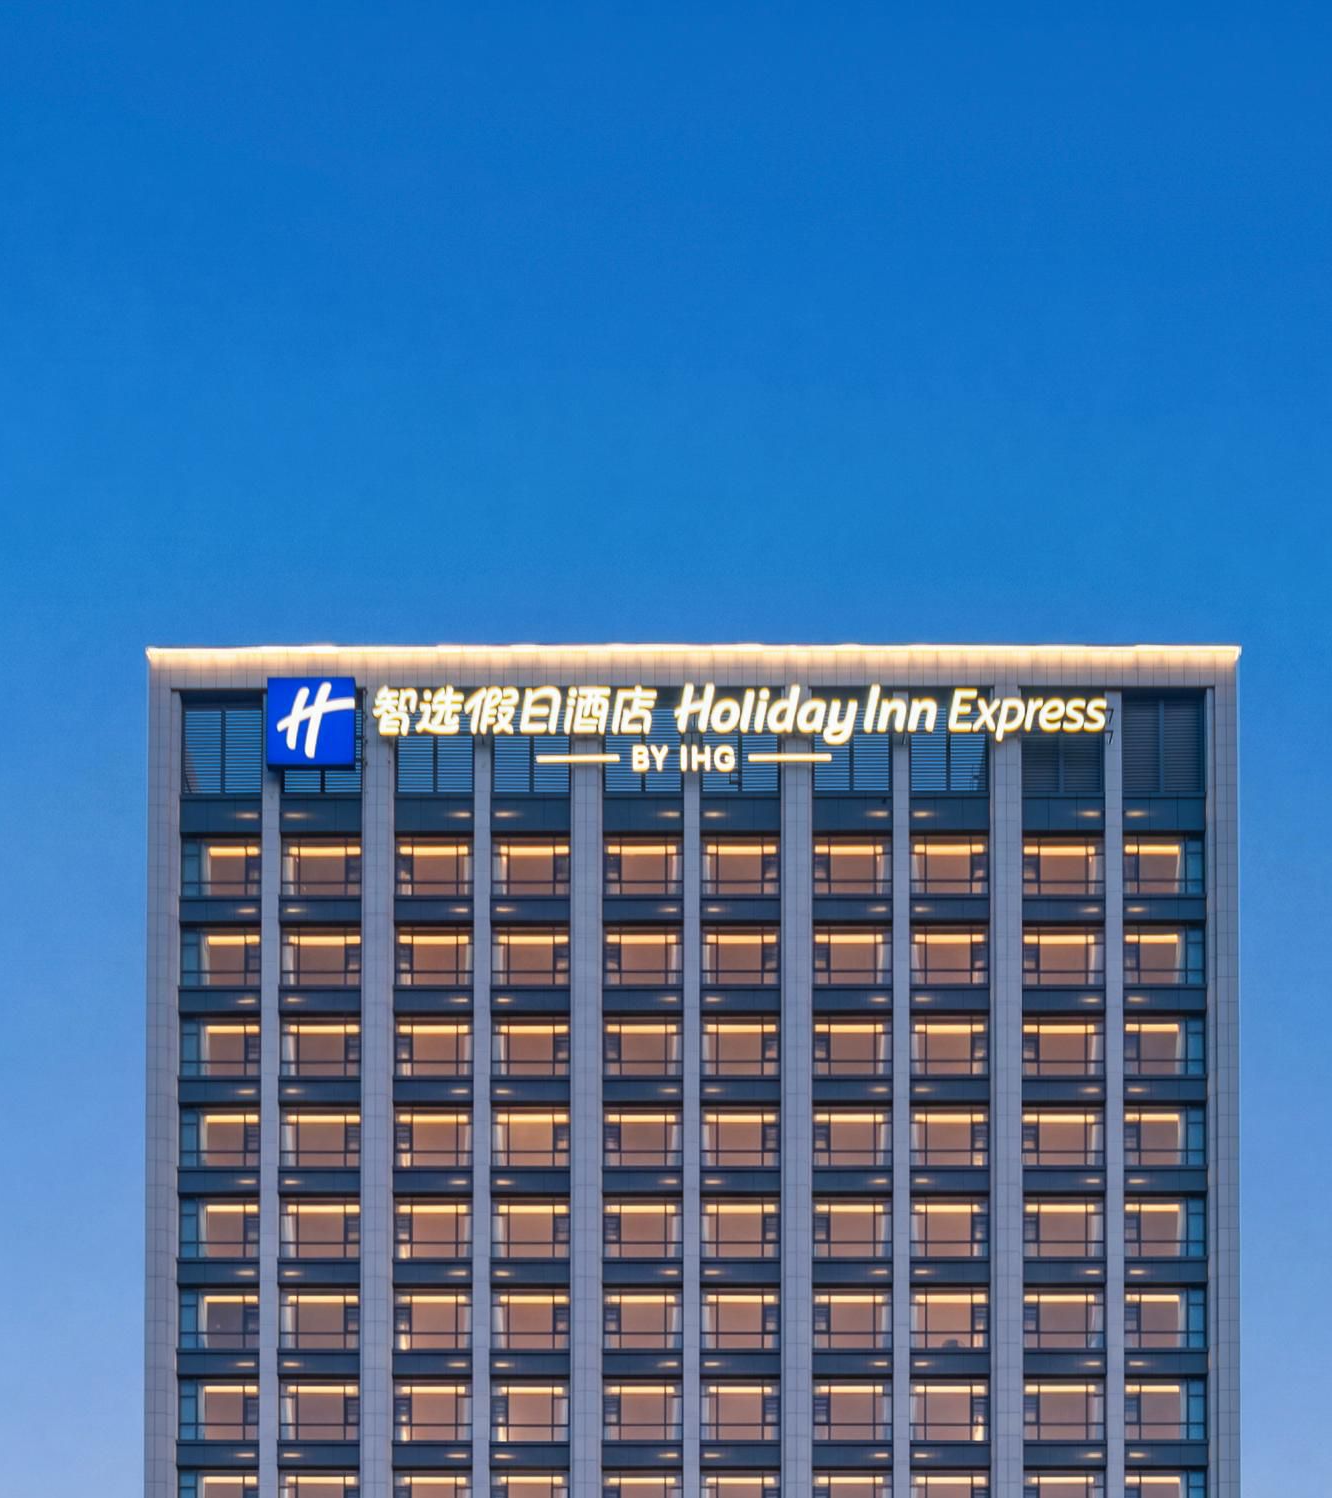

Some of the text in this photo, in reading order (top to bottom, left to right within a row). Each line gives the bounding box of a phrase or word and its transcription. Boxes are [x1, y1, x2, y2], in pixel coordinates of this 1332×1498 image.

[371, 684, 658, 736] 智选假日酒店
[675, 682, 1108, 744] Holiday Inn Express
[631, 744, 737, 773] BY IHG
